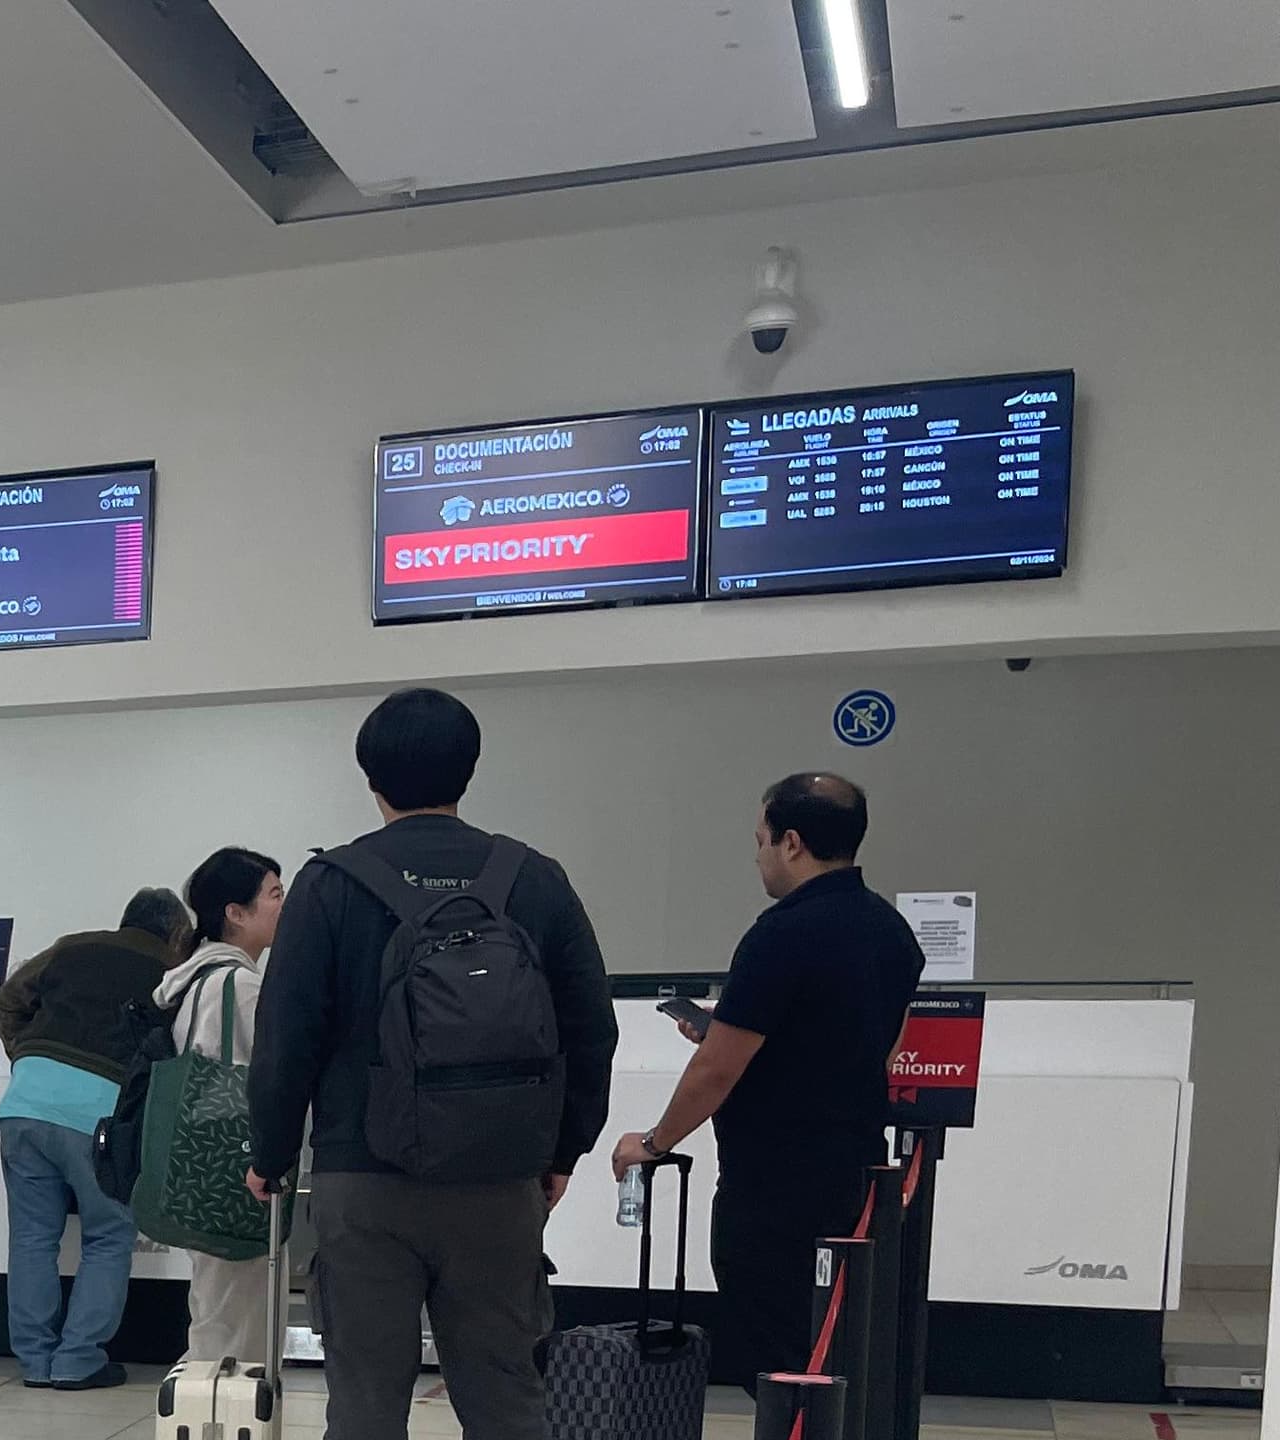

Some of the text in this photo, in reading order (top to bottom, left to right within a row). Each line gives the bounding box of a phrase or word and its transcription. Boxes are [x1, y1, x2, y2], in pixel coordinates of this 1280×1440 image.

[763, 404, 918, 432] LLEGADAS ARRIVALS
[657, 426, 688, 438] OMA
[435, 430, 572, 460] DOCUMENTACIÓN
[1000, 437, 1015, 447] ON
[1017, 435, 1040, 444] TIME
[392, 453, 415, 471] 25
[999, 454, 1014, 464] ON
[1017, 452, 1039, 462] TIME
[435, 460, 481, 475] CHECK-IN
[998, 472, 1013, 481] ON
[1016, 470, 1039, 479] TIME
[115, 485, 140, 496] OMA
[998, 488, 1012, 498] ON
[1015, 487, 1038, 496] TIME
[480, 489, 604, 516] AEROMEXICO
[423, 878, 473, 888] snow p
[892, 1064, 965, 1075] RIORITY
[1058, 1262, 1128, 1281] OMA
